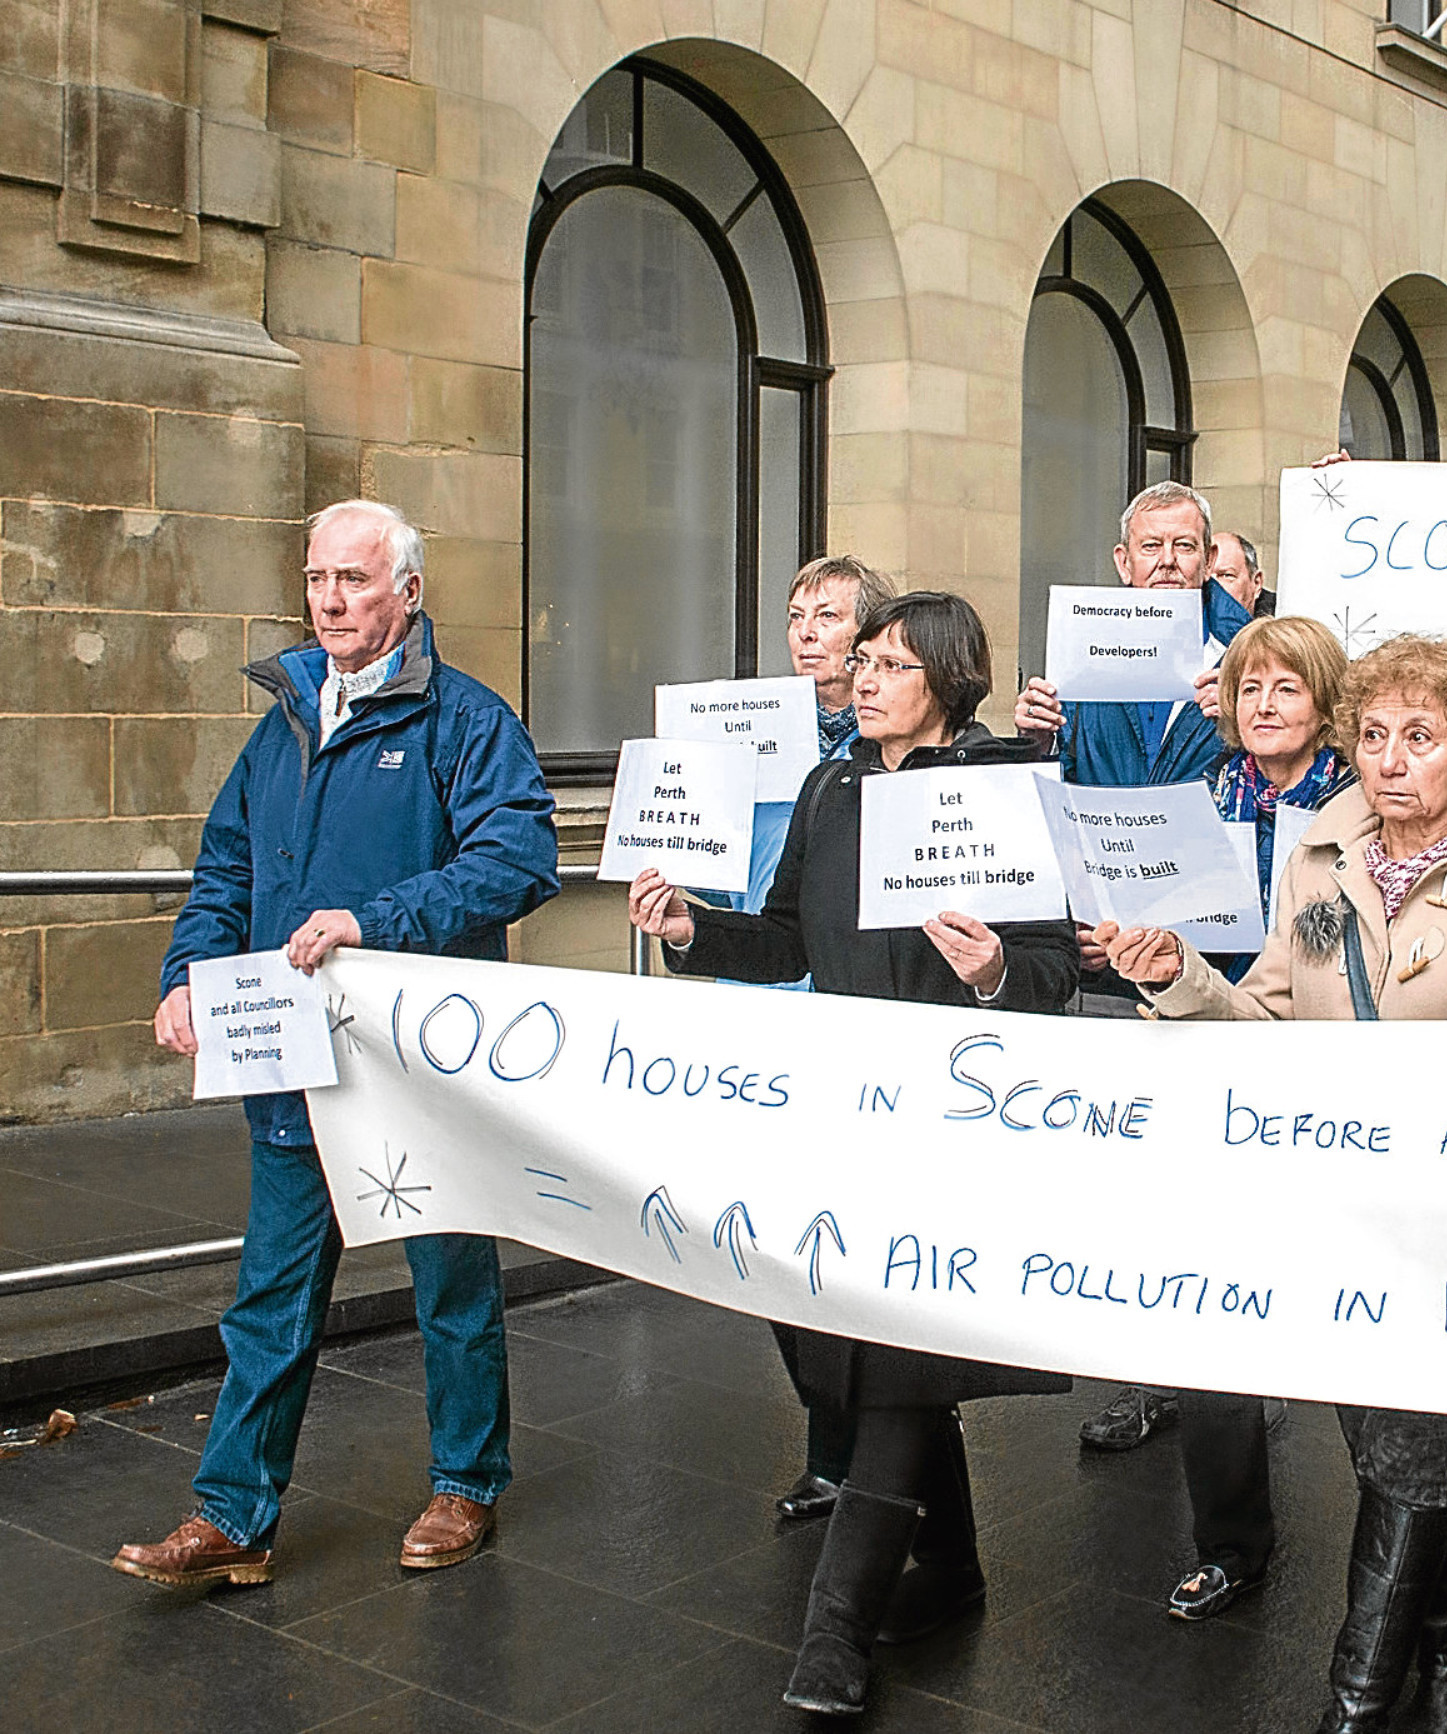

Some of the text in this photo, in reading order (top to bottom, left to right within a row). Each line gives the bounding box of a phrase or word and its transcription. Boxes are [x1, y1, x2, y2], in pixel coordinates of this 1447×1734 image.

[1073, 605, 1173, 619] Democracy before
[1090, 645, 1157, 658] Developers!
[690, 699, 780, 714] No more houses
[725, 720, 752, 733] Until
[752, 739, 778, 754] uilt
[663, 762, 682, 774] Let
[654, 786, 686, 799] Perth
[940, 792, 963, 805] Let
[639, 809, 700, 826] BREATH
[1063, 805, 1167, 827] No more houses
[932, 817, 973, 833] Perth
[617, 834, 727, 855] No houses till bridge
[914, 843, 995, 861] BREATH
[1100, 838, 1135, 853] Until
[1084, 860, 1180, 881] Bridge is built
[884, 868, 1035, 890] No houses till bridge
[236, 977, 262, 989] Scone
[211, 997, 294, 1016] and all Councillors
[227, 1021, 281, 1039] badly misled
[232, 1048, 282, 1064] by Planning
[391, 989, 568, 1083] 100
[858, 1084, 902, 1113] IN
[943, 1033, 1153, 1140] SCONE
[883, 1234, 979, 1295] AIR
[1022, 1253, 1272, 1319] POLLUTION
[1333, 1288, 1388, 1323] IN
